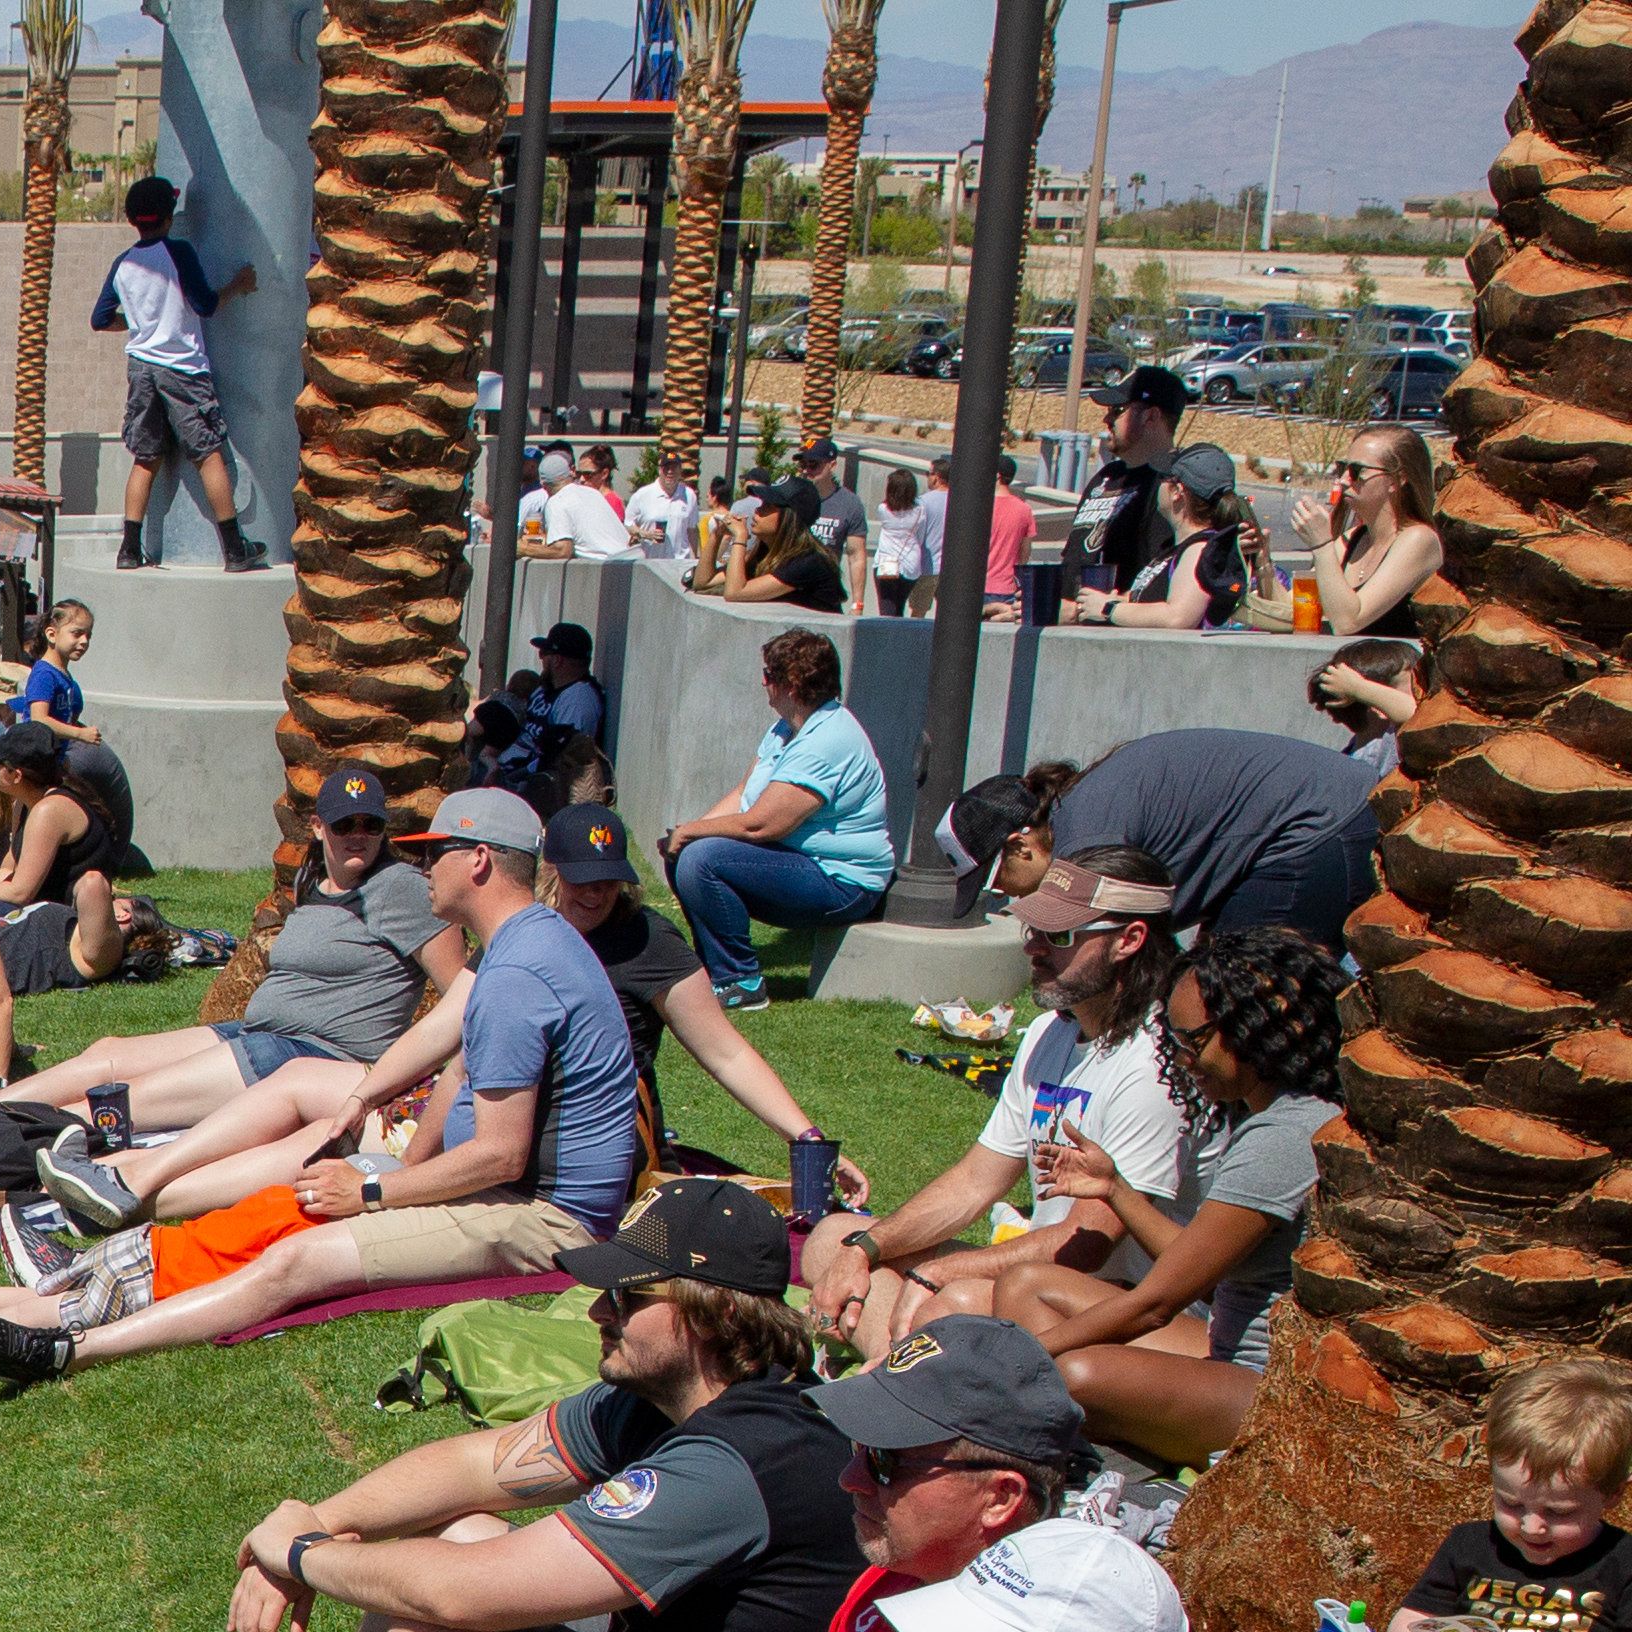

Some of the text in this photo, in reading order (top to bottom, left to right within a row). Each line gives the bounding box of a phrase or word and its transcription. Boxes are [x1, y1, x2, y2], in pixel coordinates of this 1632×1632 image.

[980, 1563, 1028, 1598] DYNAMICS
[991, 1556, 1035, 1589] Dynamic
[1468, 1578, 1607, 1617] VEGAS
